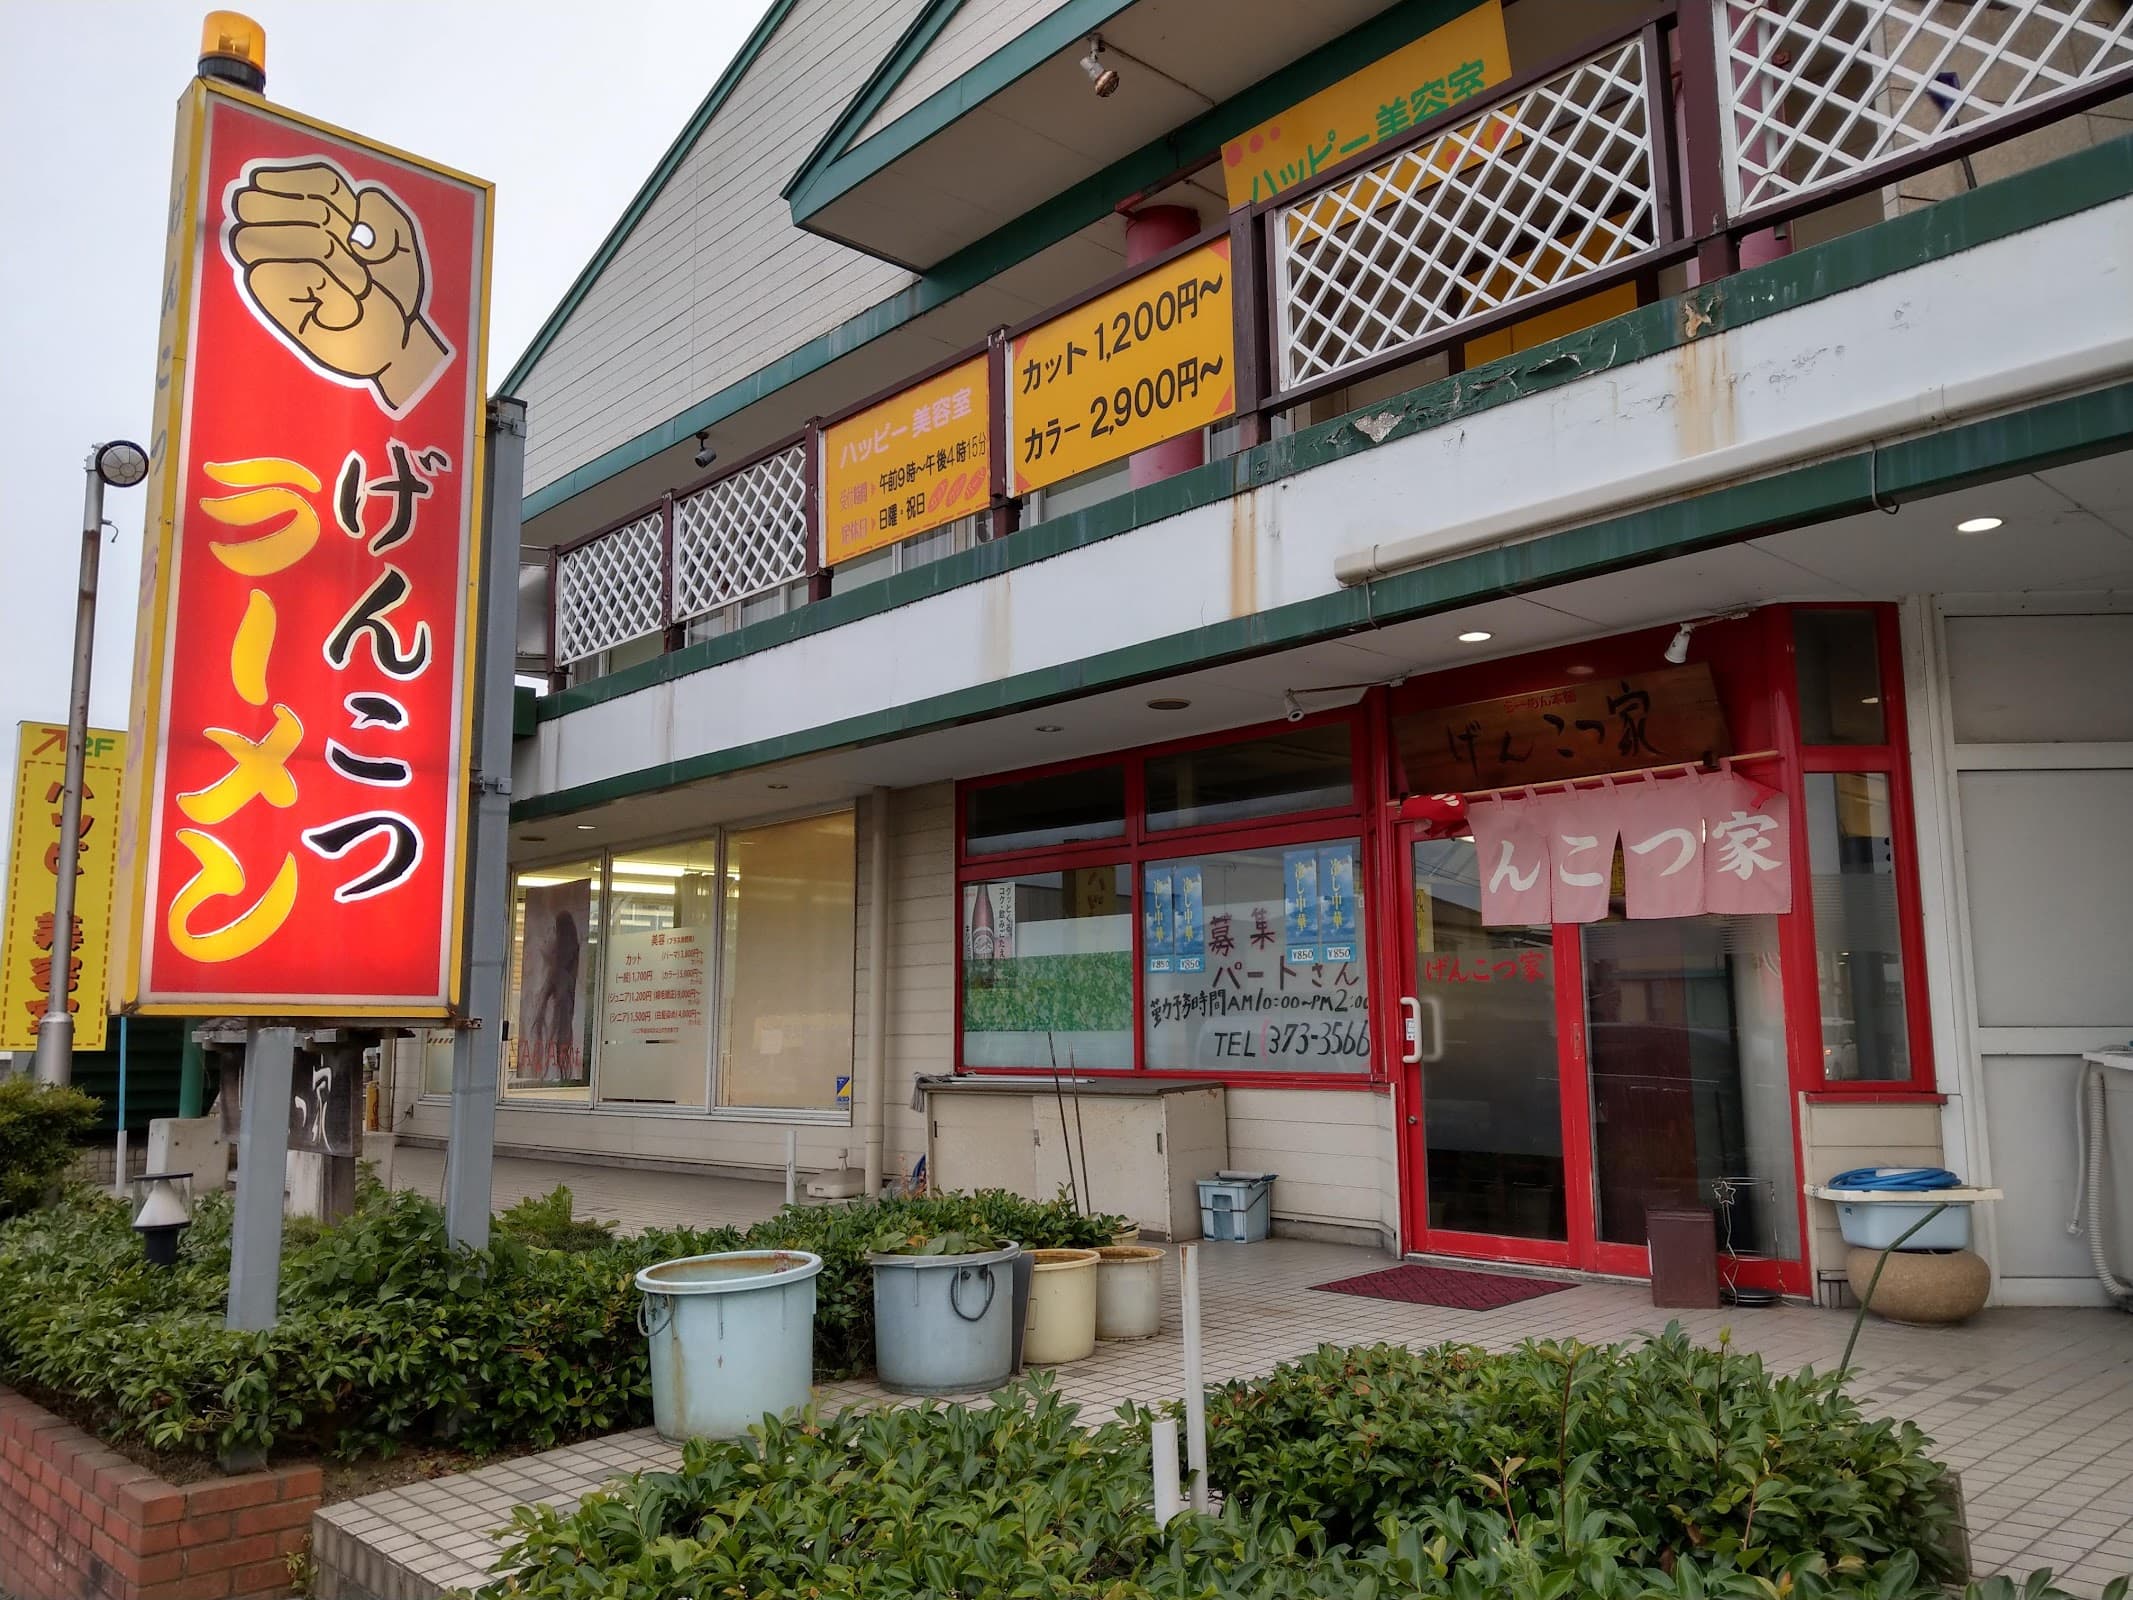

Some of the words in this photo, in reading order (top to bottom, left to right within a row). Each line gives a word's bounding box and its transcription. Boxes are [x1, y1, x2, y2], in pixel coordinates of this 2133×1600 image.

[1022, 341, 1088, 395] カット
[839, 421, 908, 469] ハッピー
[912, 388, 973, 439] 美容室
[1024, 419, 1082, 465] カラー
[301, 437, 453, 905] げんこつ
[168, 456, 322, 964] ラーメン
[1446, 680, 1668, 777] げんこつ家
[1211, 955, 1361, 991] パートさん
[1425, 950, 1546, 985] げんこつ家
[1214, 1031, 1257, 1058] TEL
